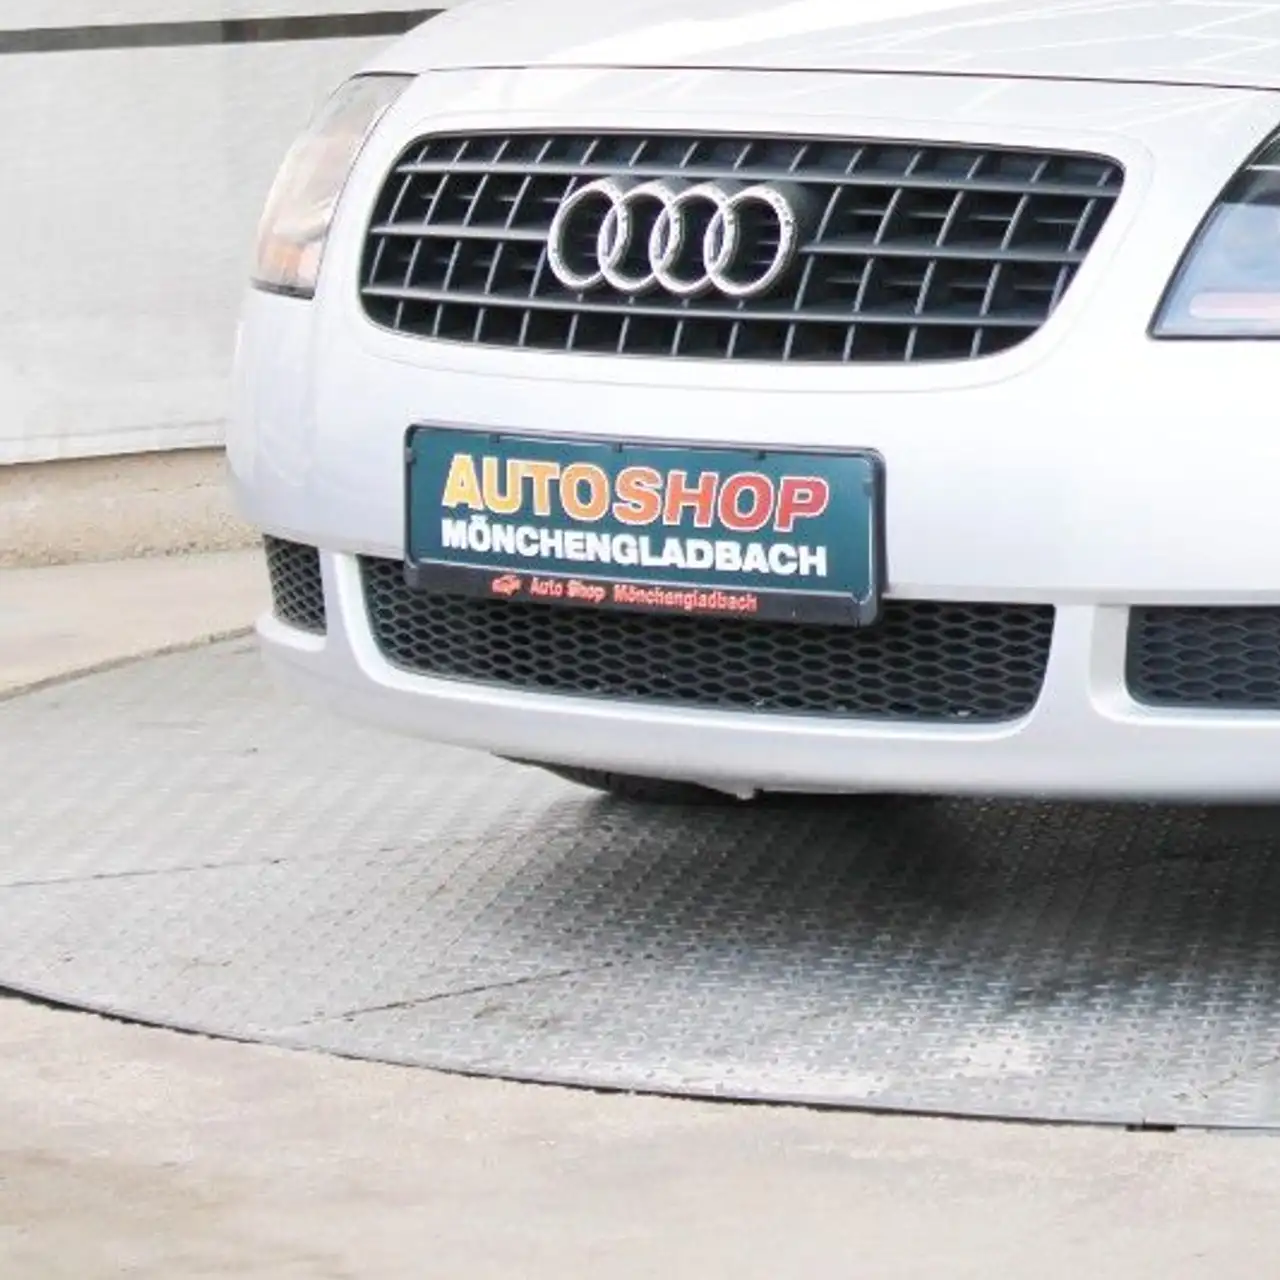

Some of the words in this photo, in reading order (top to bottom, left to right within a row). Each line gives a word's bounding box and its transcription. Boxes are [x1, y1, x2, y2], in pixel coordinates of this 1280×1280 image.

[441, 516, 828, 577] MÖNCHENGLADBACH
[530, 576, 563, 597] Auto
[566, 580, 606, 603] Shop
[613, 584, 759, 612] Mönchengladbach
